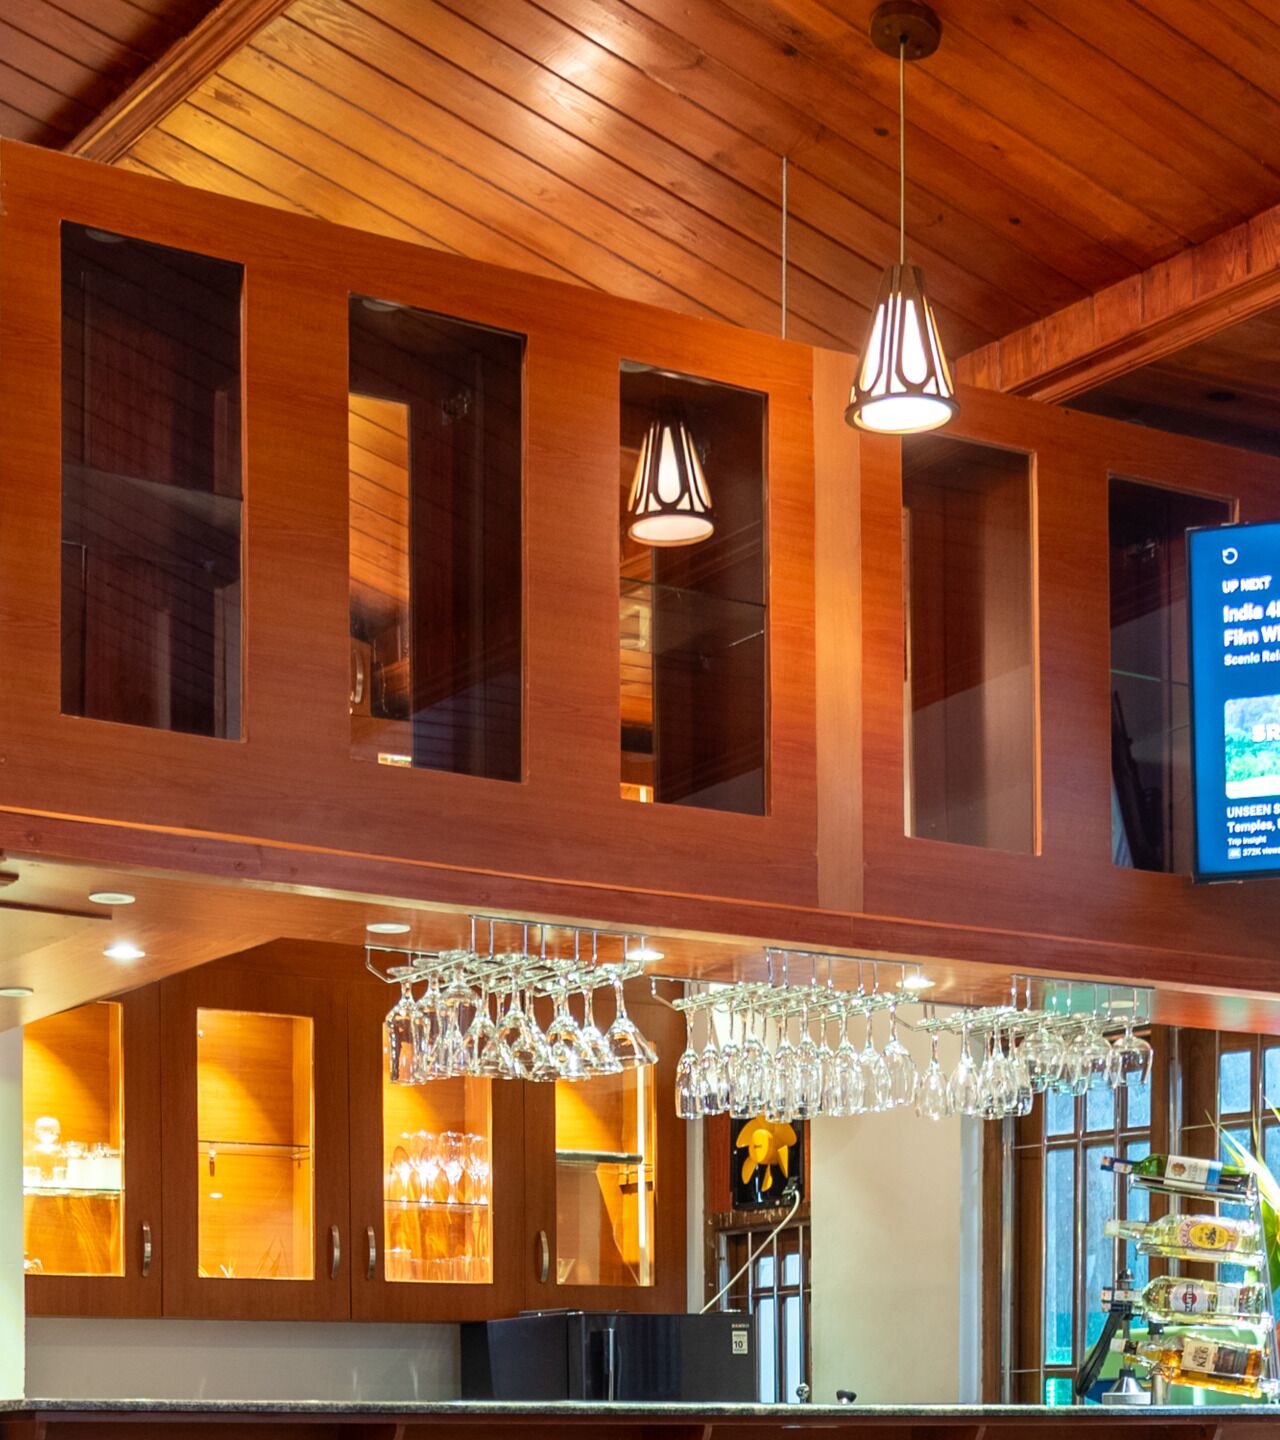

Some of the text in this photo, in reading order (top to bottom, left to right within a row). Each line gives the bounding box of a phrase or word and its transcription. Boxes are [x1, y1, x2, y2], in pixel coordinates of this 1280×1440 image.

[1222, 575, 1272, 594] UP NEXT
[1223, 602, 1264, 624] India
[1223, 627, 1259, 648] Film
[1224, 651, 1261, 667] Scenic
[1226, 801, 1272, 818] UNSEEN
[1227, 819, 1276, 834] Temples,
[1227, 834, 1267, 847] Trip Insight
